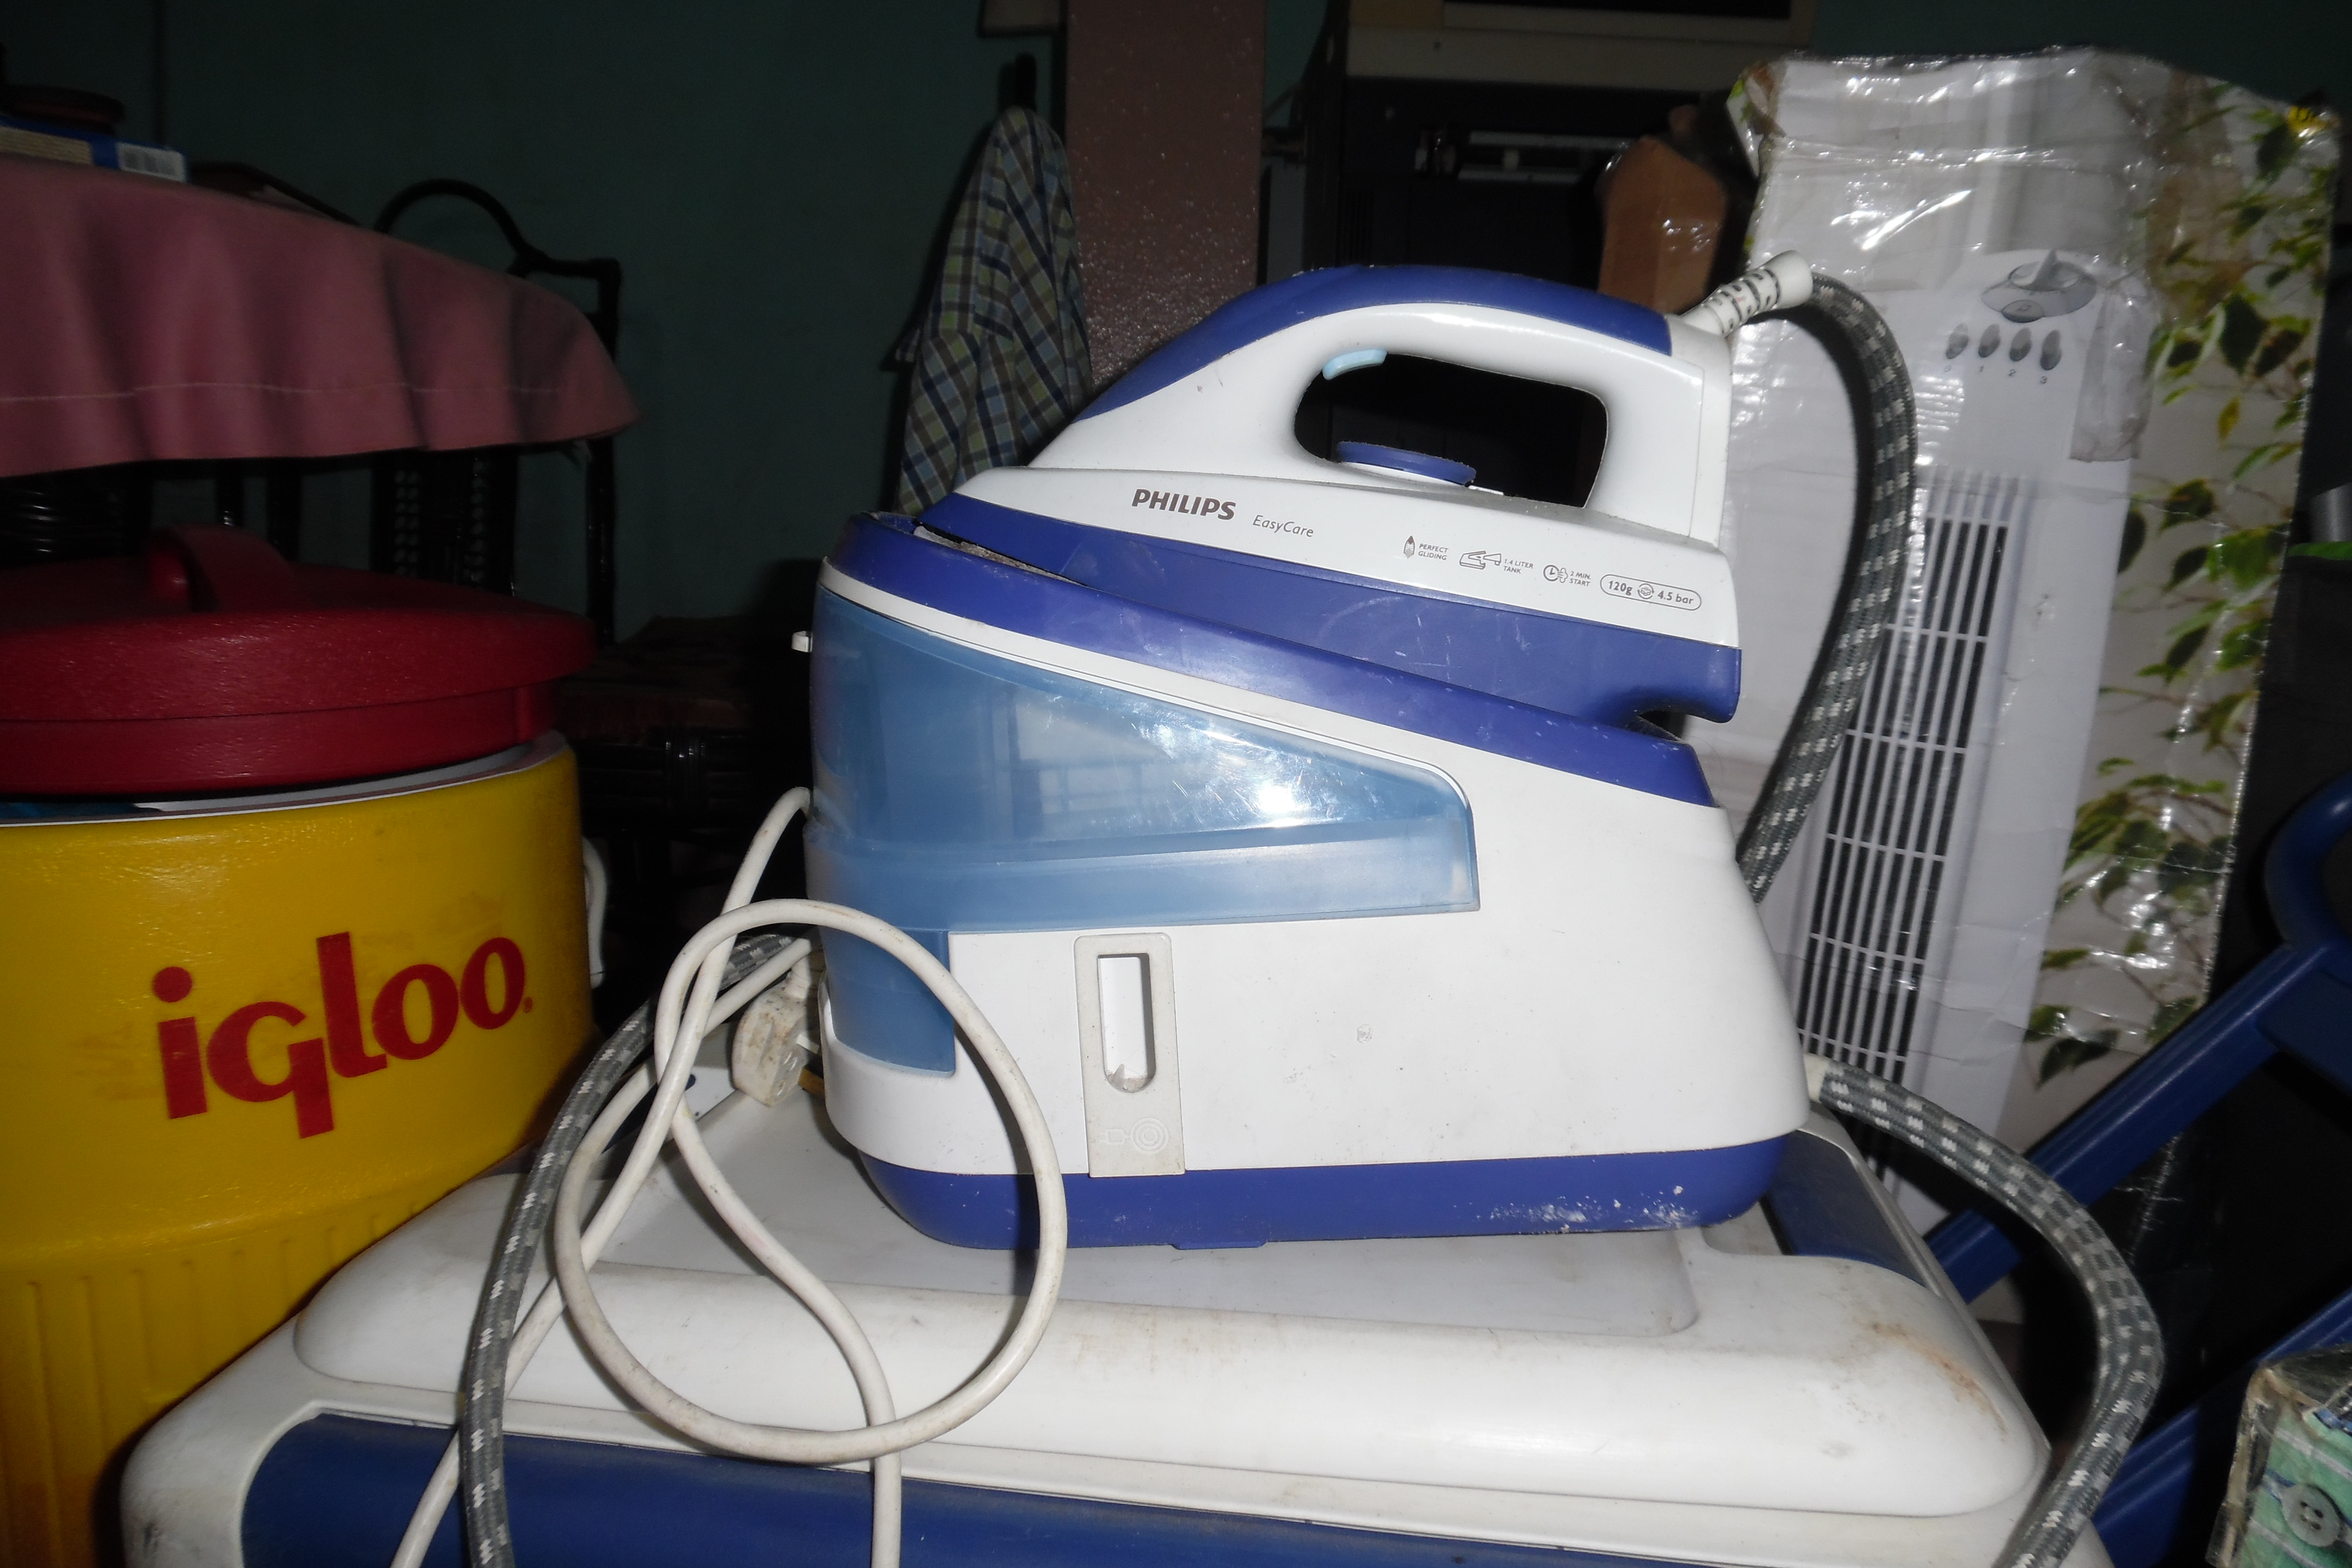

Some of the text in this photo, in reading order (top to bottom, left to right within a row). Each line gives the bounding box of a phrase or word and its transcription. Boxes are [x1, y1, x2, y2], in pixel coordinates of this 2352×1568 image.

[2040, 376, 2048, 384] 3
[1131, 488, 1236, 521] PHILIPS
[1252, 514, 1314, 537] EasyCare
[1419, 543, 1449, 553] PERFECT
[1418, 551, 1448, 560] GLIDING
[1514, 560, 1534, 569] LITER
[1504, 566, 1522, 574] TANK
[1576, 572, 1591, 580] MIN.
[1570, 578, 1591, 586] START
[1608, 580, 1694, 604] 120g 4.5 bar
[152, 932, 525, 1139] igloo
